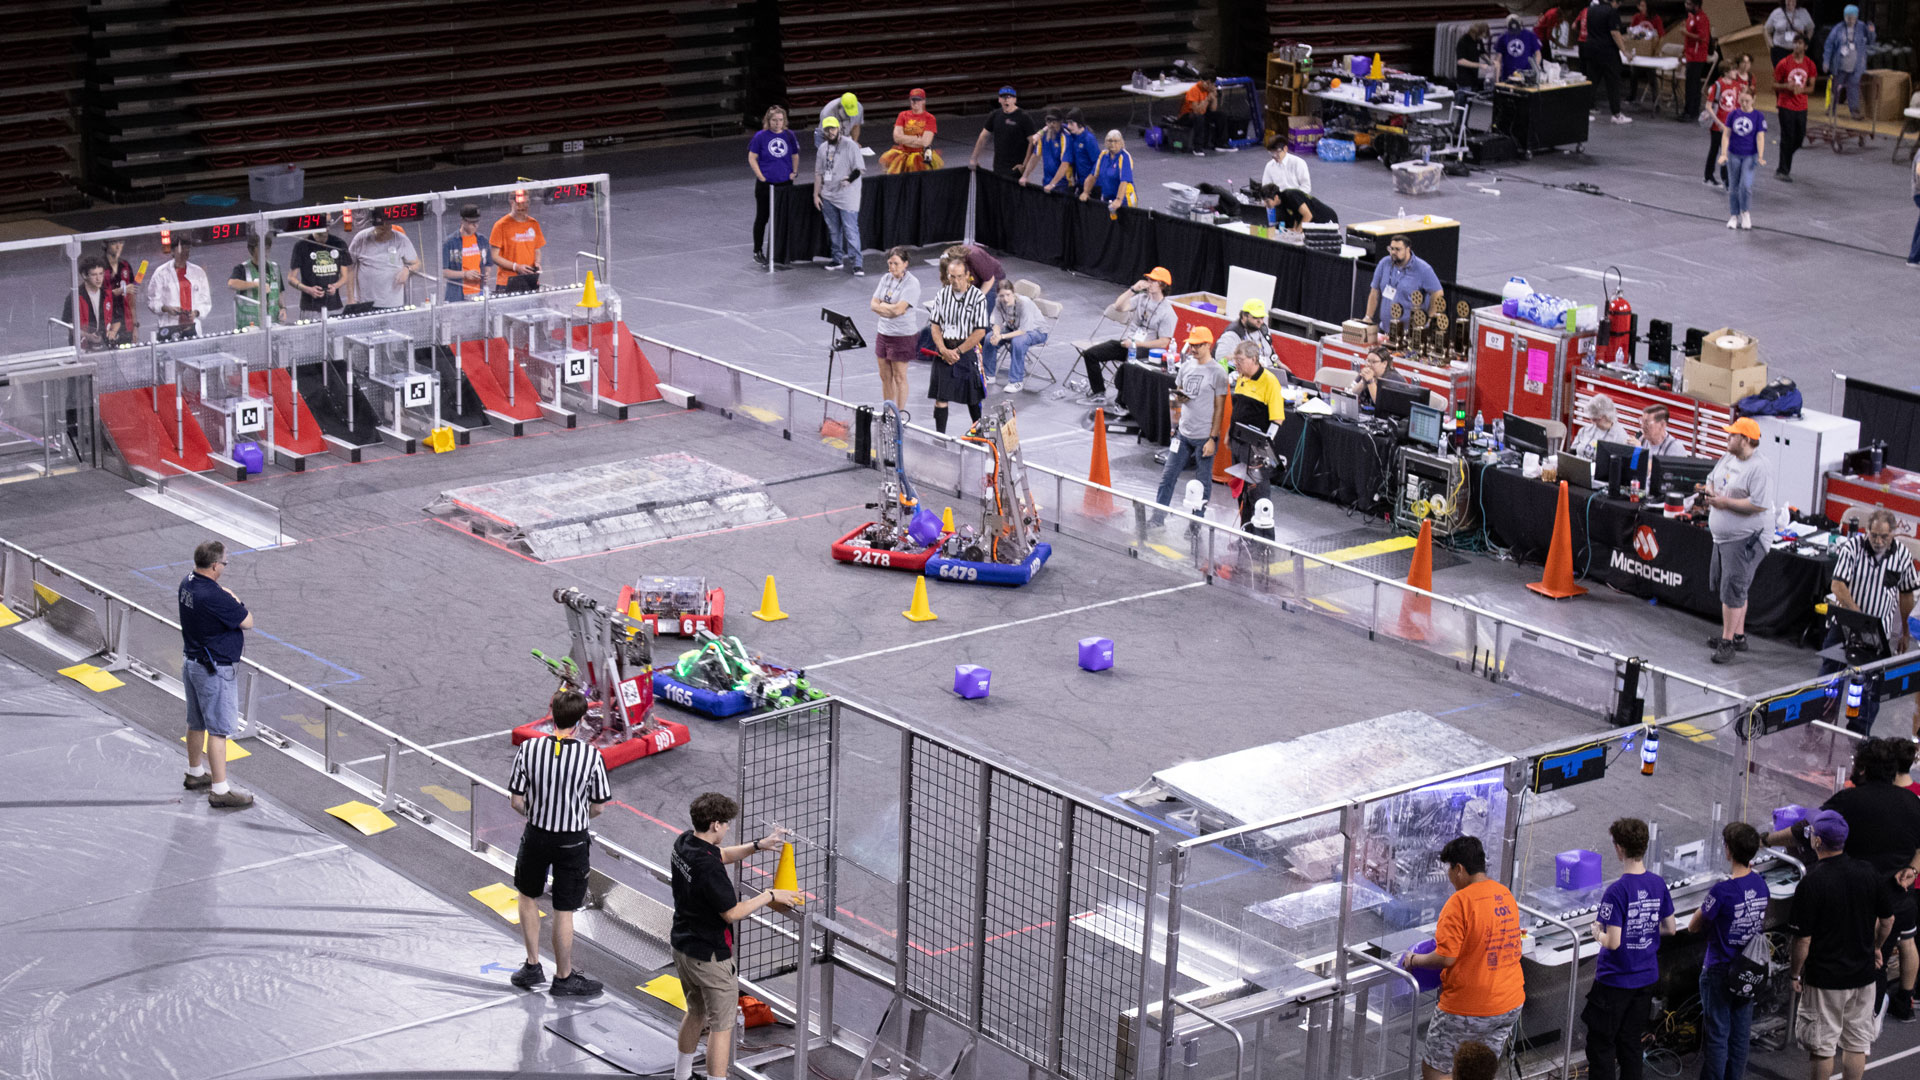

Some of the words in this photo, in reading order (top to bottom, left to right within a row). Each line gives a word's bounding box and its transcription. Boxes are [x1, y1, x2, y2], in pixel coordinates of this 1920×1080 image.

[554, 183, 588, 199] 2478
[384, 203, 417, 219] 4565
[298, 214, 321, 229] 134
[212, 223, 240, 239] 991
[853, 549, 890, 567] 2478
[939, 564, 978, 581] 6479
[1610, 549, 1683, 587] MICROCHIP
[664, 683, 693, 707] 1165
[1786, 703, 1797, 719] 2
[654, 729, 675, 751] 991
